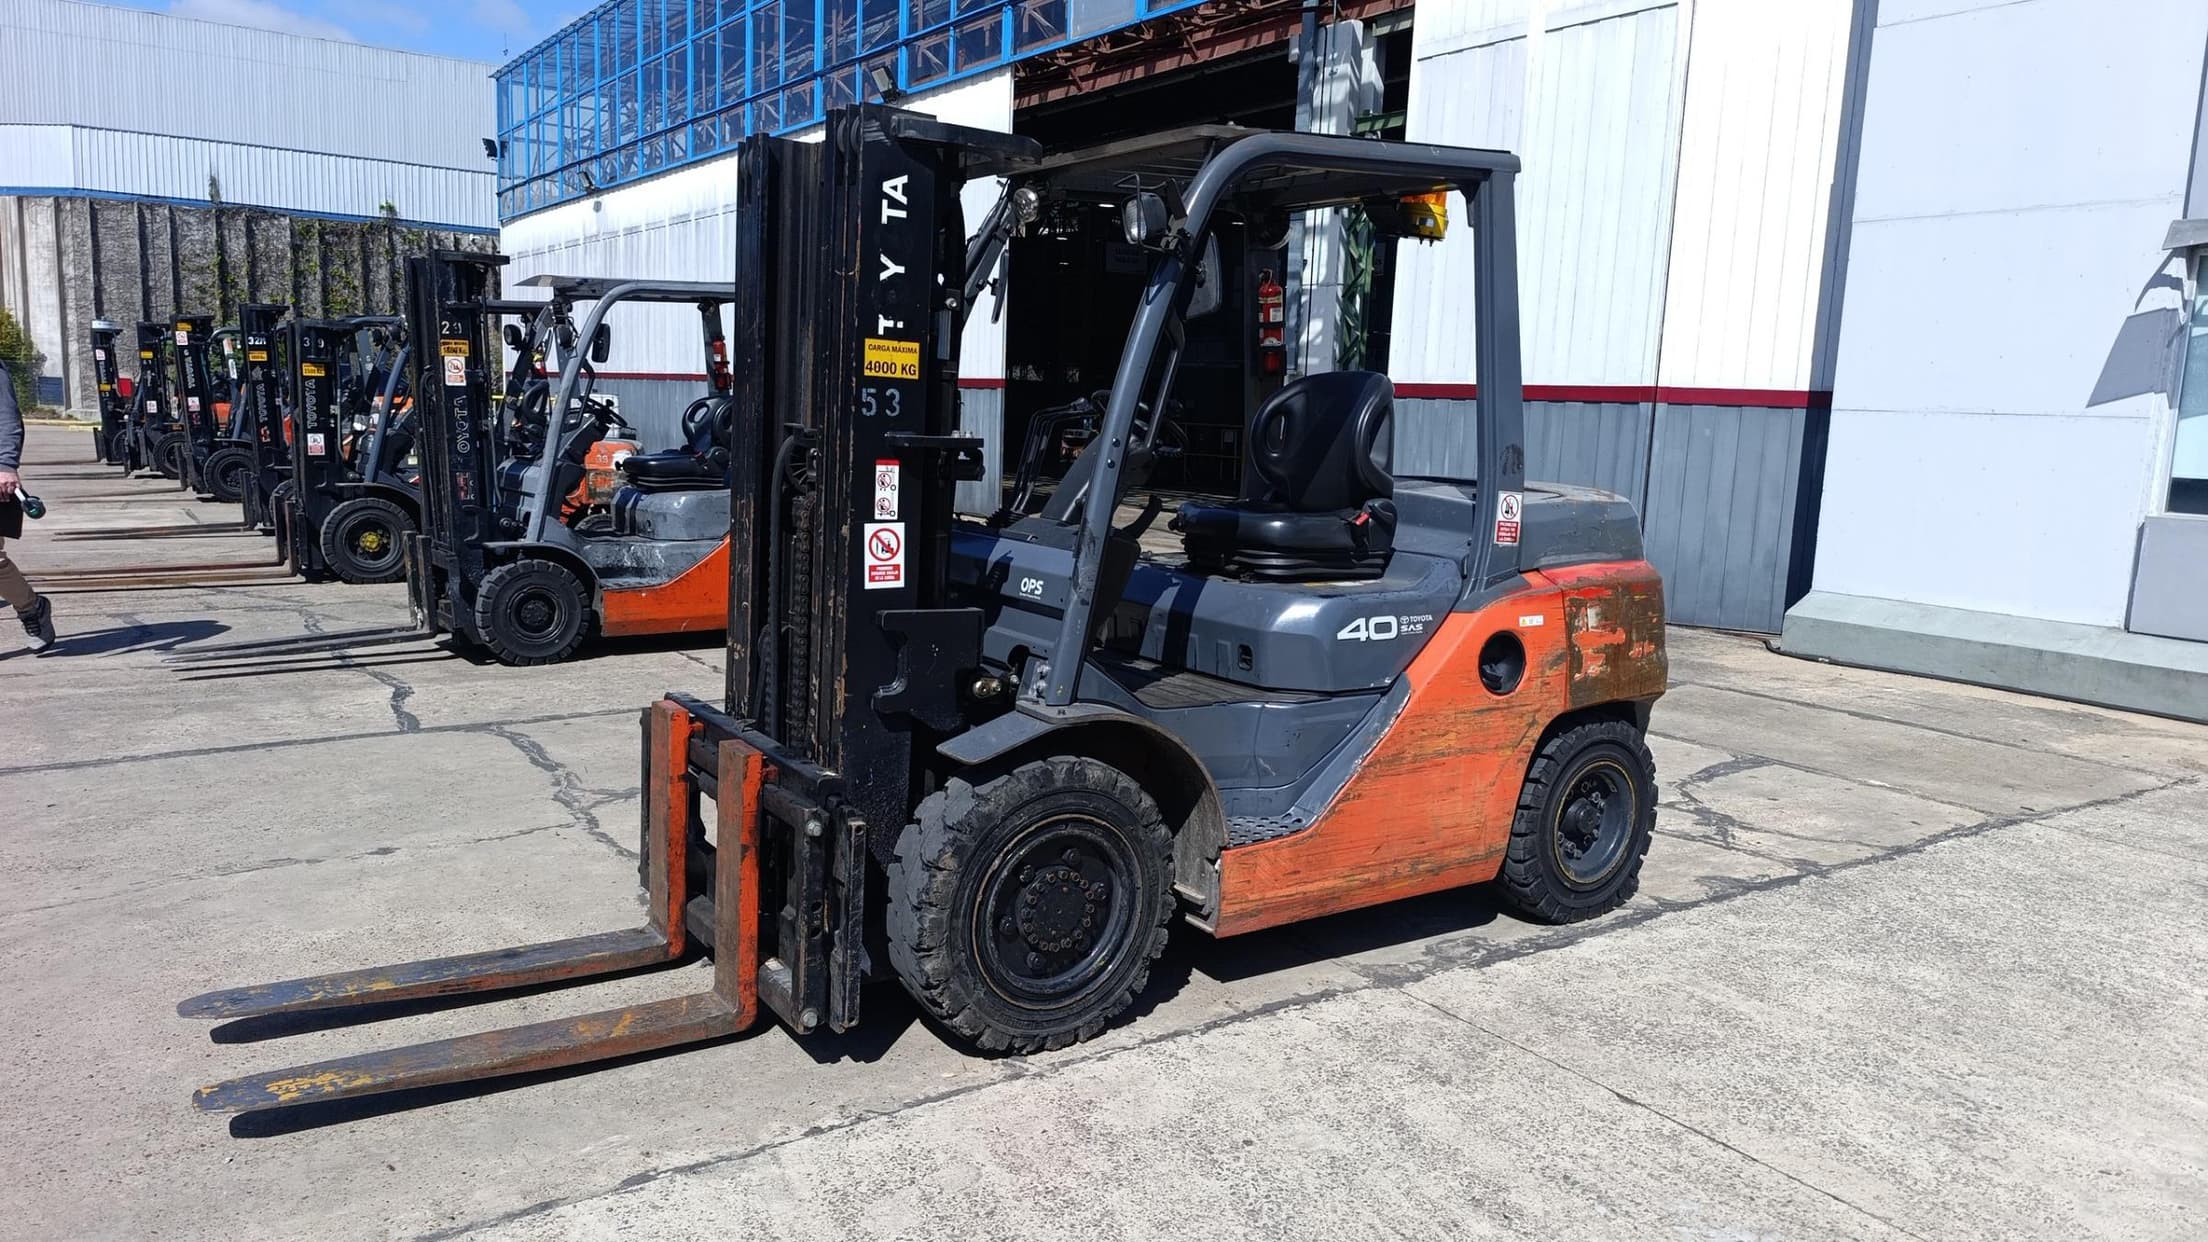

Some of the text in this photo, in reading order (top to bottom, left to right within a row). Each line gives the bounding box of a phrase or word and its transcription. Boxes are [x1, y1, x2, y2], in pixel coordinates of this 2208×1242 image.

[868, 343, 891, 352] CARGA
[865, 360, 917, 376] 4000 KG
[861, 387, 900, 417] 53
[1020, 577, 1044, 595] OPS
[1409, 614, 1433, 622] TOYOTA
[1336, 615, 1398, 642] 40
[1400, 623, 1424, 632] SAS
